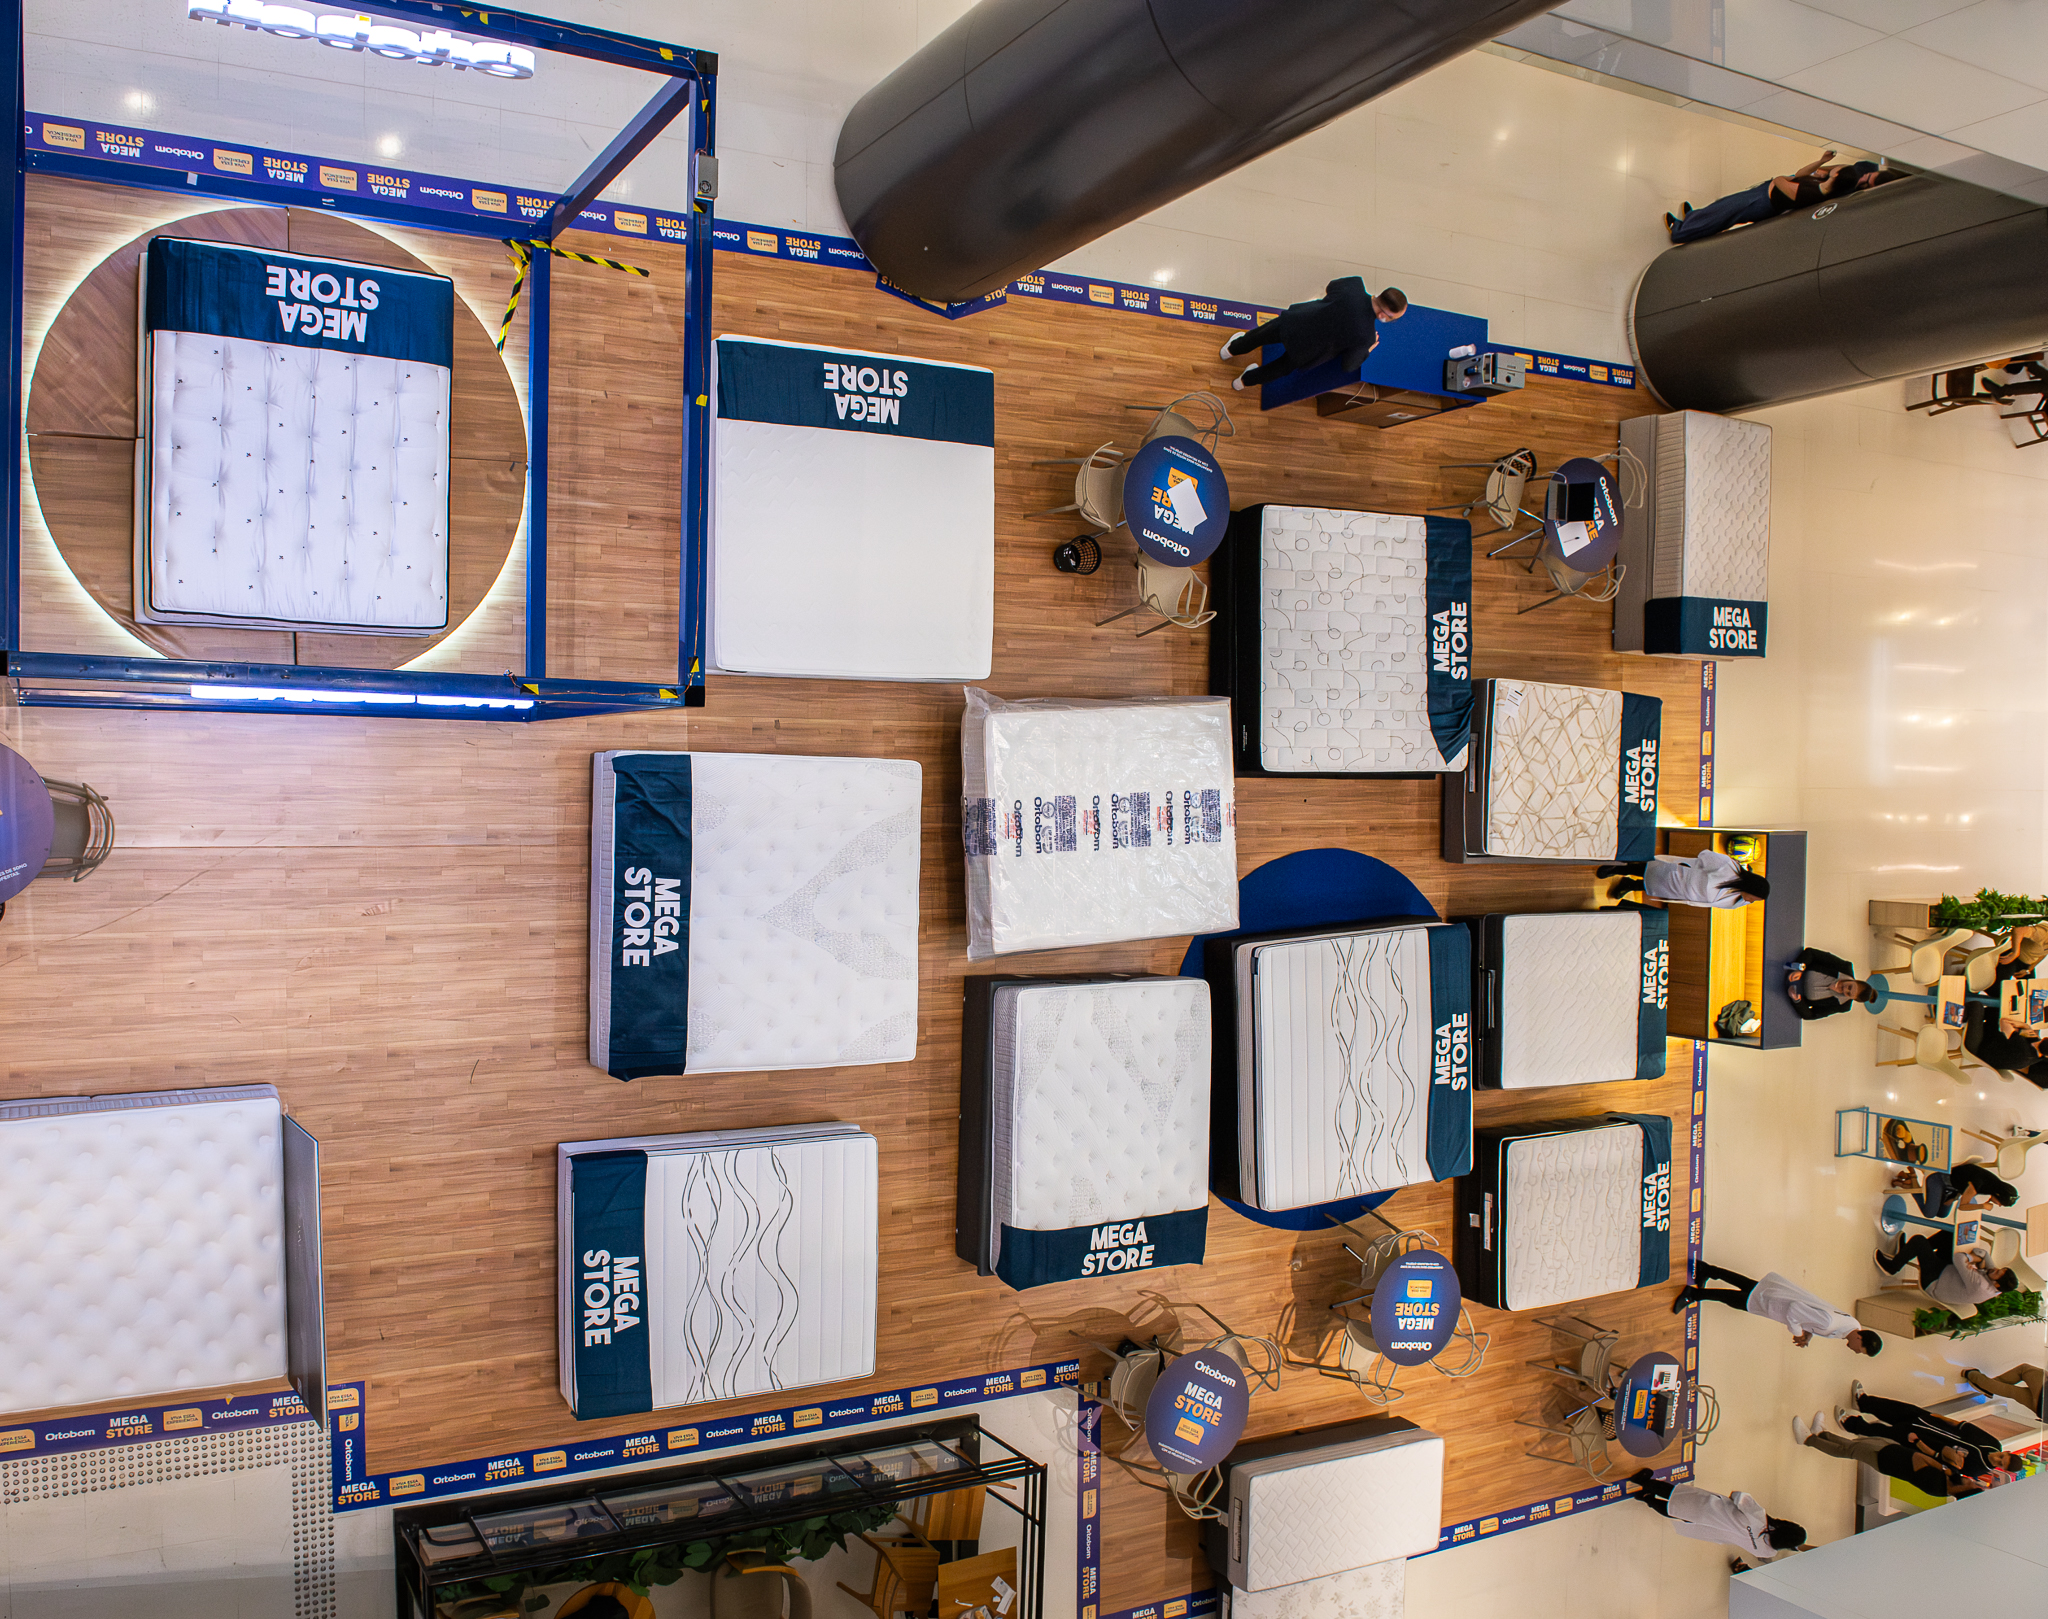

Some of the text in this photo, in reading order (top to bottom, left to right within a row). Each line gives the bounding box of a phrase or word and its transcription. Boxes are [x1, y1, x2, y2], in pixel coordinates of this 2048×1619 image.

[96, 131, 144, 147] STORE
[101, 143, 140, 157] MEGA
[155, 145, 204, 160] Ortobom
[263, 157, 308, 173] STORE
[267, 168, 303, 183] MEGA
[367, 173, 410, 188] STORE
[371, 185, 407, 198] MEGA
[420, 186, 464, 200] Ortobom
[579, 210, 606, 221] Ortob
[656, 217, 686, 230] TORE
[786, 236, 821, 250] STORE
[789, 247, 818, 259] MEGA
[828, 248, 864, 259] Ortobom
[266, 265, 380, 310] STORE
[1017, 283, 1042, 293] MEGA
[1051, 283, 1083, 294] Ortobom
[1121, 290, 1149, 301] STORE
[1124, 299, 1147, 309] MEGA
[1190, 301, 1217, 312] STORE
[278, 301, 367, 342] MEGA
[1193, 310, 1215, 320] MEGA
[1223, 310, 1252, 320] Ortobom
[1537, 356, 1559, 366] STORE
[1539, 364, 1558, 373] MEGA
[1612, 368, 1633, 378] STORE
[824, 362, 908, 397] STORE
[1614, 376, 1632, 385] MEGA
[834, 393, 899, 425] MEGA
[1600, 476, 1618, 526] Ortobom
[1142, 528, 1190, 557] Ortobom
[1713, 606, 1751, 628] MEGA
[1433, 610, 1450, 672] MEGA
[1451, 602, 1468, 680] STORE
[1709, 628, 1758, 650] STORE
[1624, 747, 1640, 804] MEGA
[1640, 739, 1657, 812] STORE
[1111, 793, 1119, 849] Ortobom
[1183, 790, 1191, 844] Ortobom
[1034, 796, 1042, 854] Ortobom
[623, 867, 652, 966] STORE
[653, 878, 681, 956] MEGA
[1643, 947, 1658, 1003] MEGA
[1435, 1023, 1451, 1084] MEGA
[1451, 1013, 1468, 1090] STORE
[1644, 1172, 1658, 1227] MEGA
[1657, 1161, 1670, 1231] STORE
[1091, 1222, 1148, 1250] MEGA
[1082, 1245, 1155, 1275] STORE
[584, 1250, 611, 1347] STORE
[614, 1256, 640, 1333] MEGA
[1395, 1302, 1440, 1316] STORE
[1398, 1318, 1434, 1330] MEGA
[1391, 1342, 1432, 1350] Ortobom
[986, 1375, 1011, 1386] MEGA
[1054, 1371, 1079, 1383] STOR
[1195, 1361, 1236, 1387] Ortobom
[944, 1387, 977, 1398] Ortobom
[983, 1382, 1014, 1395] STORE
[272, 1395, 303, 1407] MEG
[874, 1394, 901, 1406] MEGA
[1184, 1382, 1222, 1410] MEGA
[871, 1402, 904, 1415] STORE
[1174, 1395, 1222, 1426] STORE
[1670, 1380, 1681, 1428] Ortobom
[212, 1407, 258, 1420] Ortobom
[829, 1406, 864, 1418] Ortobom
[110, 1414, 148, 1428] MEGA
[754, 1415, 782, 1426] MEGA
[45, 1428, 96, 1441] Ortobom
[106, 1424, 152, 1439] STORE
[706, 1427, 743, 1438] Ortobom
[751, 1422, 786, 1436] STORE
[625, 1435, 656, 1448] MEGA
[574, 1449, 614, 1461] Ortobom
[622, 1444, 660, 1458] STORE
[488, 1457, 521, 1471] MEGA
[433, 1472, 476, 1485] Ortobom
[485, 1466, 524, 1481] STORE
[341, 1481, 376, 1494] MEGA
[338, 1490, 380, 1505] STORE
[1133, 1607, 1155, 1618] MEGA
